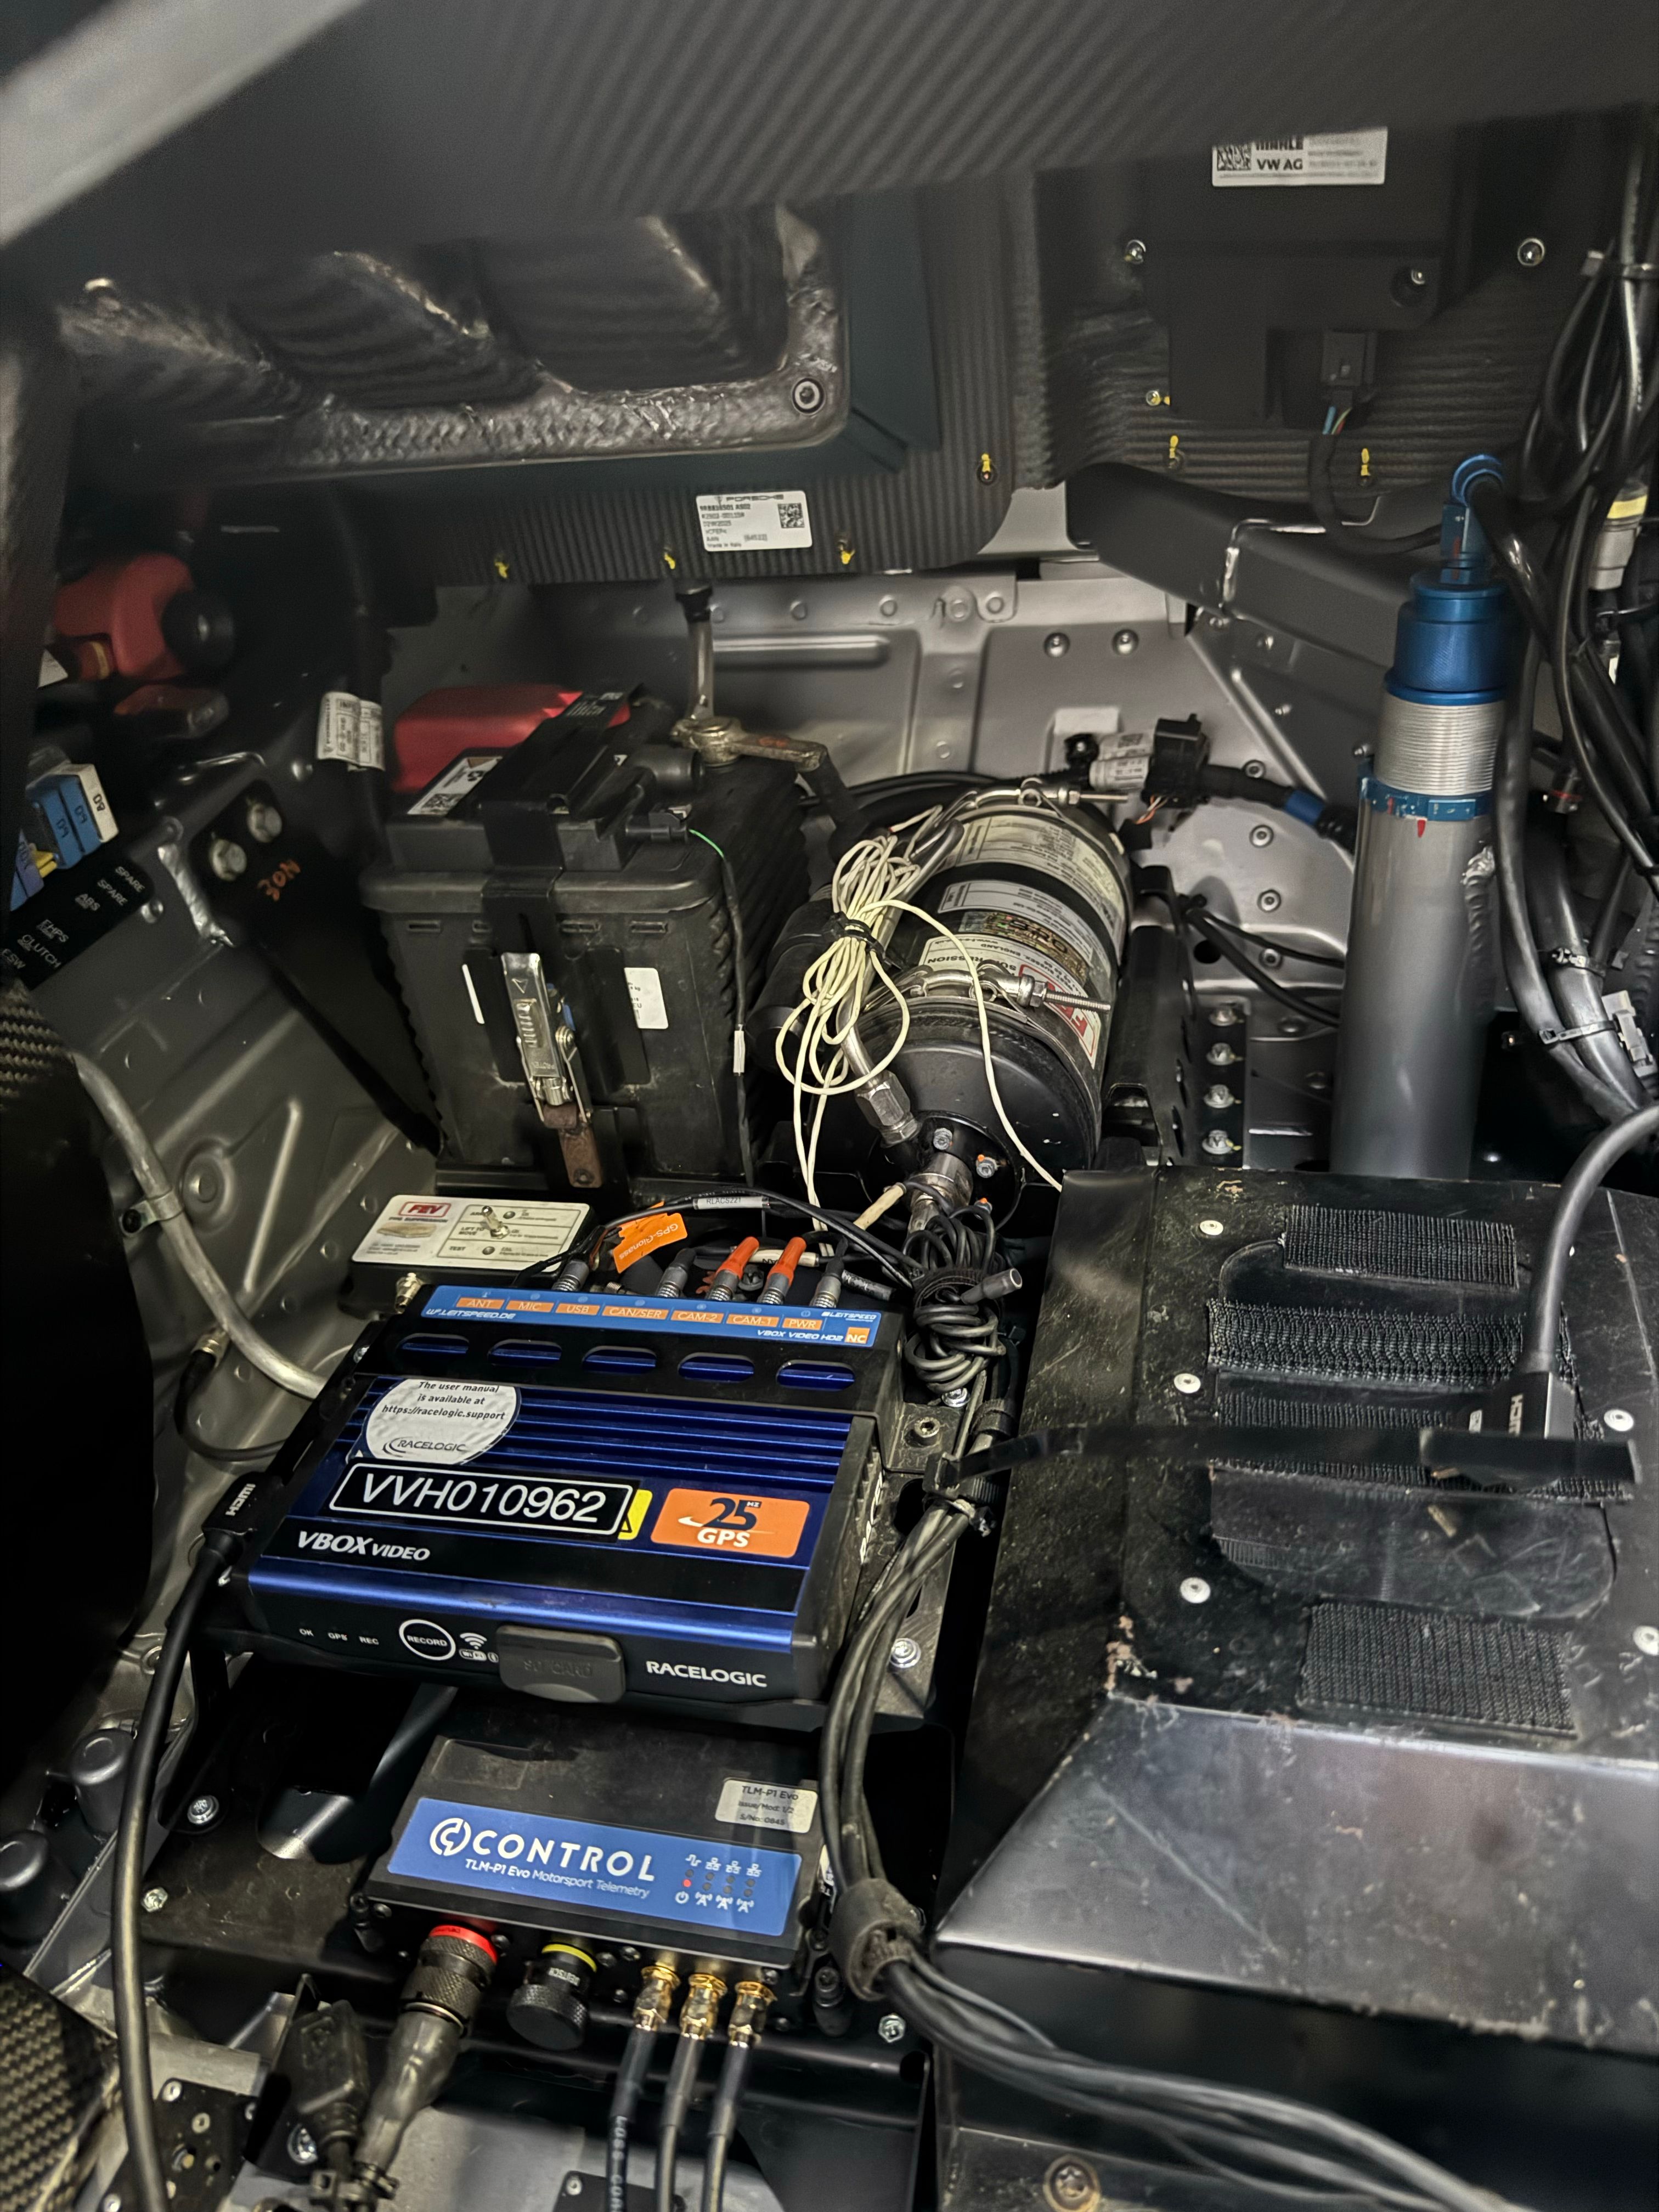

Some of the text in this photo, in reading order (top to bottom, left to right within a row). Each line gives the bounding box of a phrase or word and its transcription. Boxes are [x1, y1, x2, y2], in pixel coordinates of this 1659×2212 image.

[1257, 158, 1303, 171] VW AG
[115, 866, 145, 893] SPARE
[97, 879, 128, 906] SPARE
[408, 1204, 443, 1214] FEV
[619, 1223, 678, 1260] GPS-Glonass
[467, 1299, 492, 1308] ANT
[518, 1301, 541, 1311] MIC
[566, 1305, 590, 1314] USB
[610, 1307, 662, 1318] CAN/SER
[678, 1311, 718, 1322] CAM-2
[733, 1315, 773, 1326] CAM-1
[789, 1319, 817, 1329] PWR
[757, 1329, 786, 1338] VBOX
[789, 1331, 820, 1340] VIDEO
[847, 1334, 867, 1342] NC
[419, 1381, 437, 1390] The
[462, 1385, 500, 1393] manual
[417, 1393, 486, 1405] is available at
[381, 1405, 506, 1420] https://racelogic.support
[397, 1439, 467, 1452] RACELOGIC
[363, 1472, 607, 1523] VVH010962
[702, 1497, 758, 1531] 25
[697, 1527, 751, 1548] GPS
[297, 1530, 431, 1562] VBOX VIDEO
[299, 1628, 314, 1637] OK
[328, 1632, 348, 1641] GPS
[359, 1635, 380, 1645] REC
[406, 1634, 448, 1647] RECORD
[646, 1660, 768, 1688] RACELOGIC
[741, 1785, 799, 1801] TLM-P1 Evo
[472, 1829, 656, 1882] CONTROL
[465, 1858, 651, 1900] TLM-P1 Evo Motorsport Telemetry
